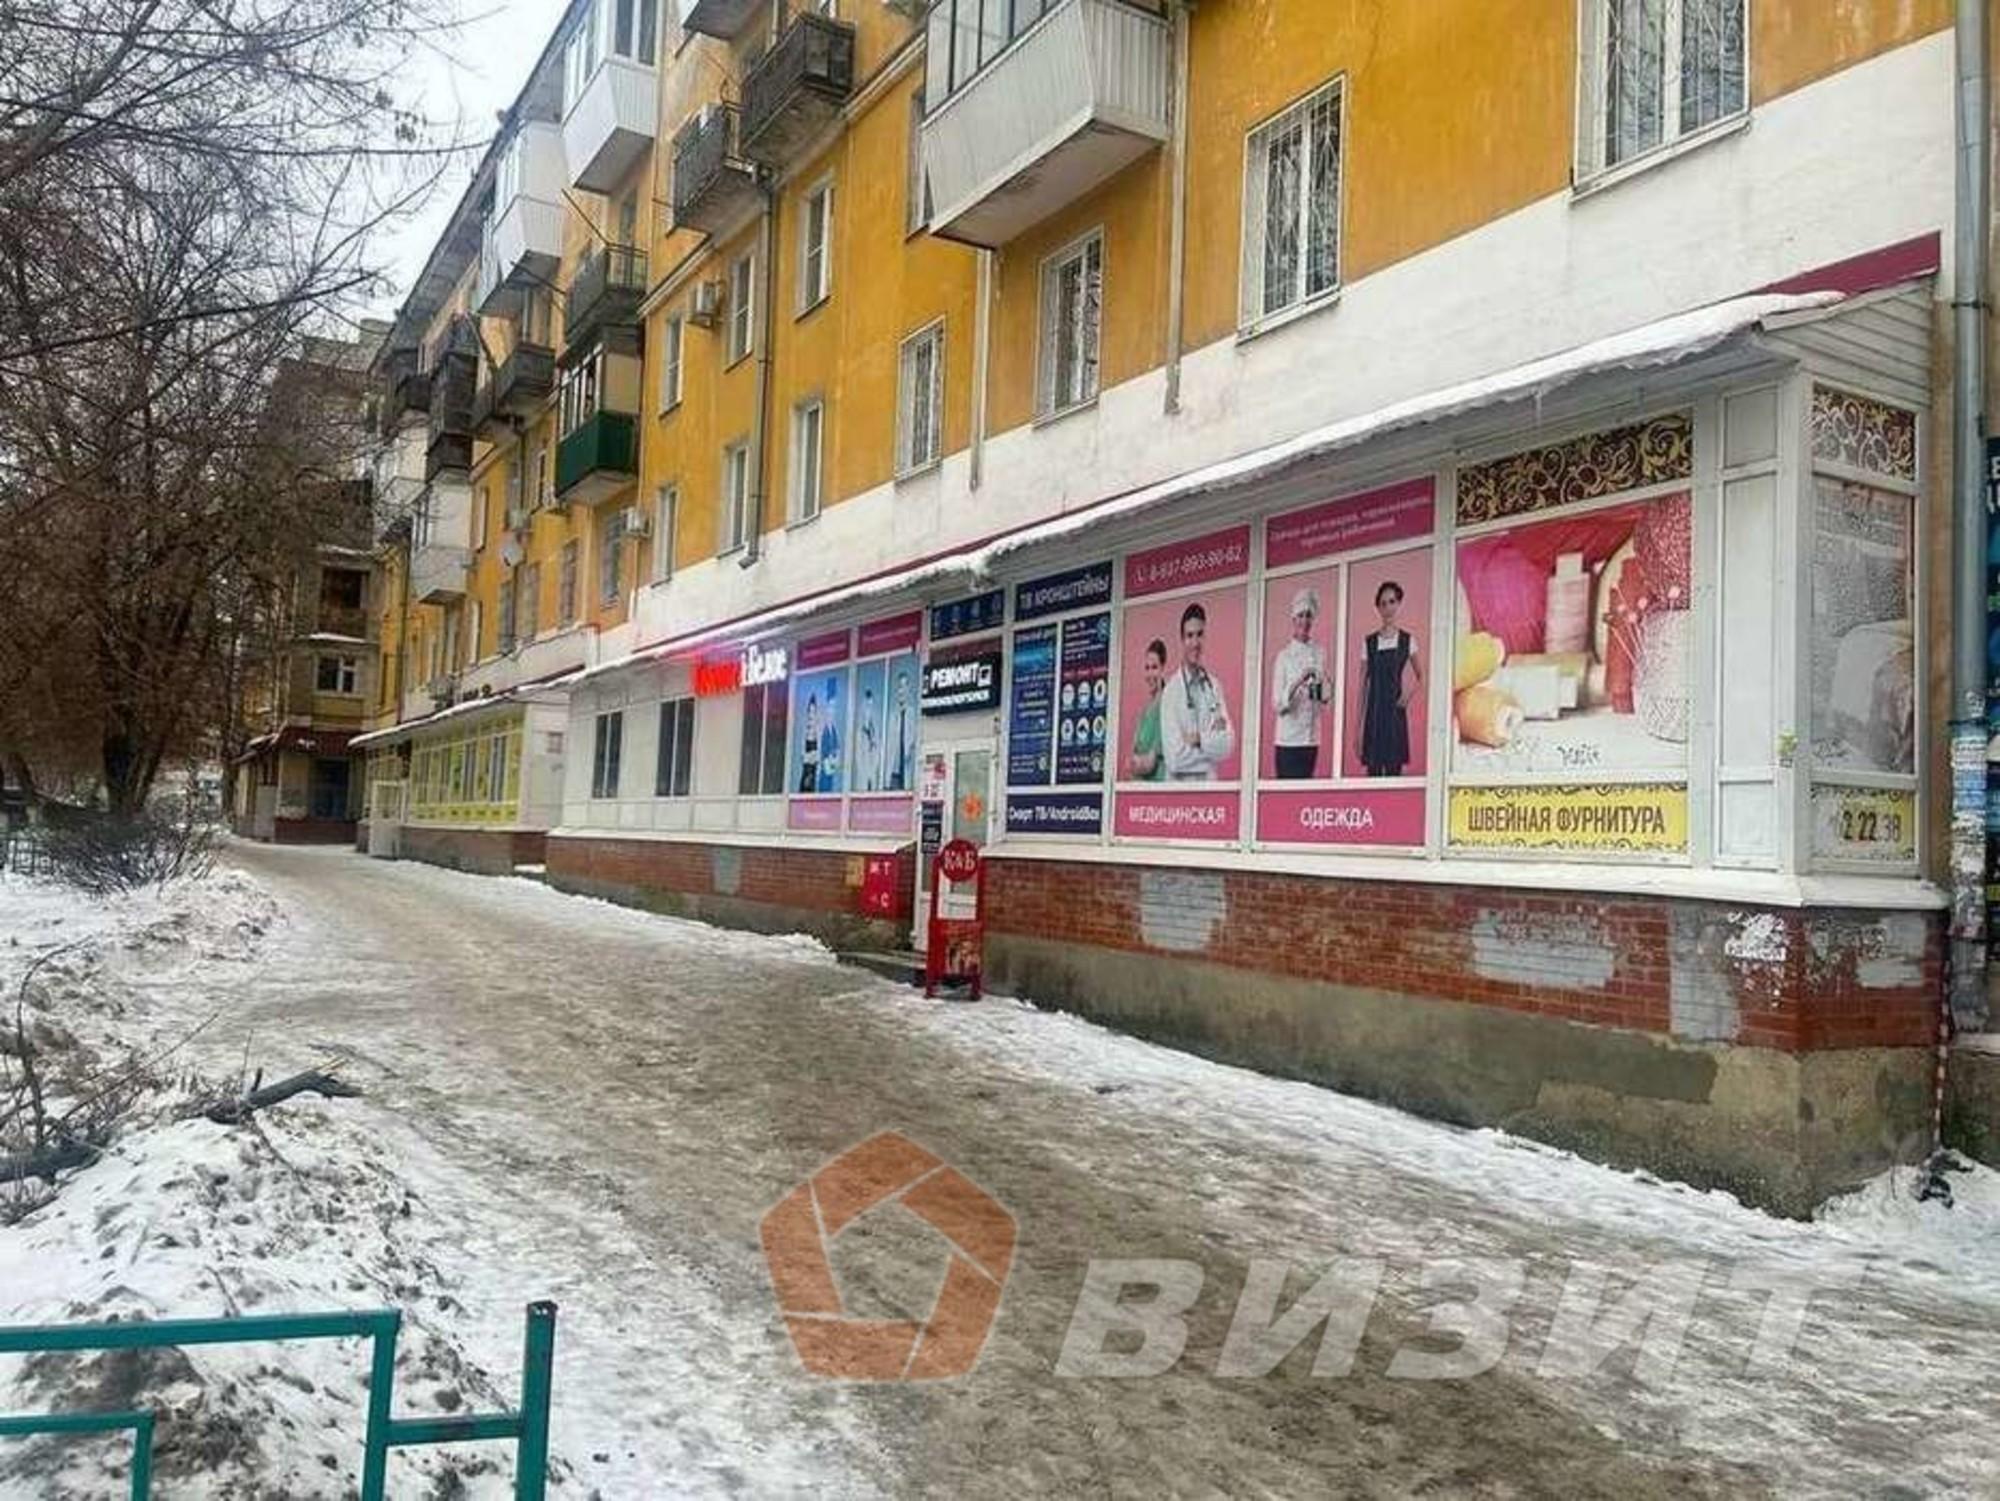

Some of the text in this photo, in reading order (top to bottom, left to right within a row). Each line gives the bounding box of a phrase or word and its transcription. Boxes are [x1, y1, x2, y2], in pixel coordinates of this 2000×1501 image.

[1034, 573, 1109, 606] КРОНШТЕЙНЫ
[930, 662, 980, 689] РЕМОНТ
[1129, 807, 1226, 825] МЕДИЦИНСКАЯ
[1300, 807, 1374, 829] ОДЕЖДА
[1468, 803, 1665, 834] ШВЕЙНАЯ ФУРНИТУРА
